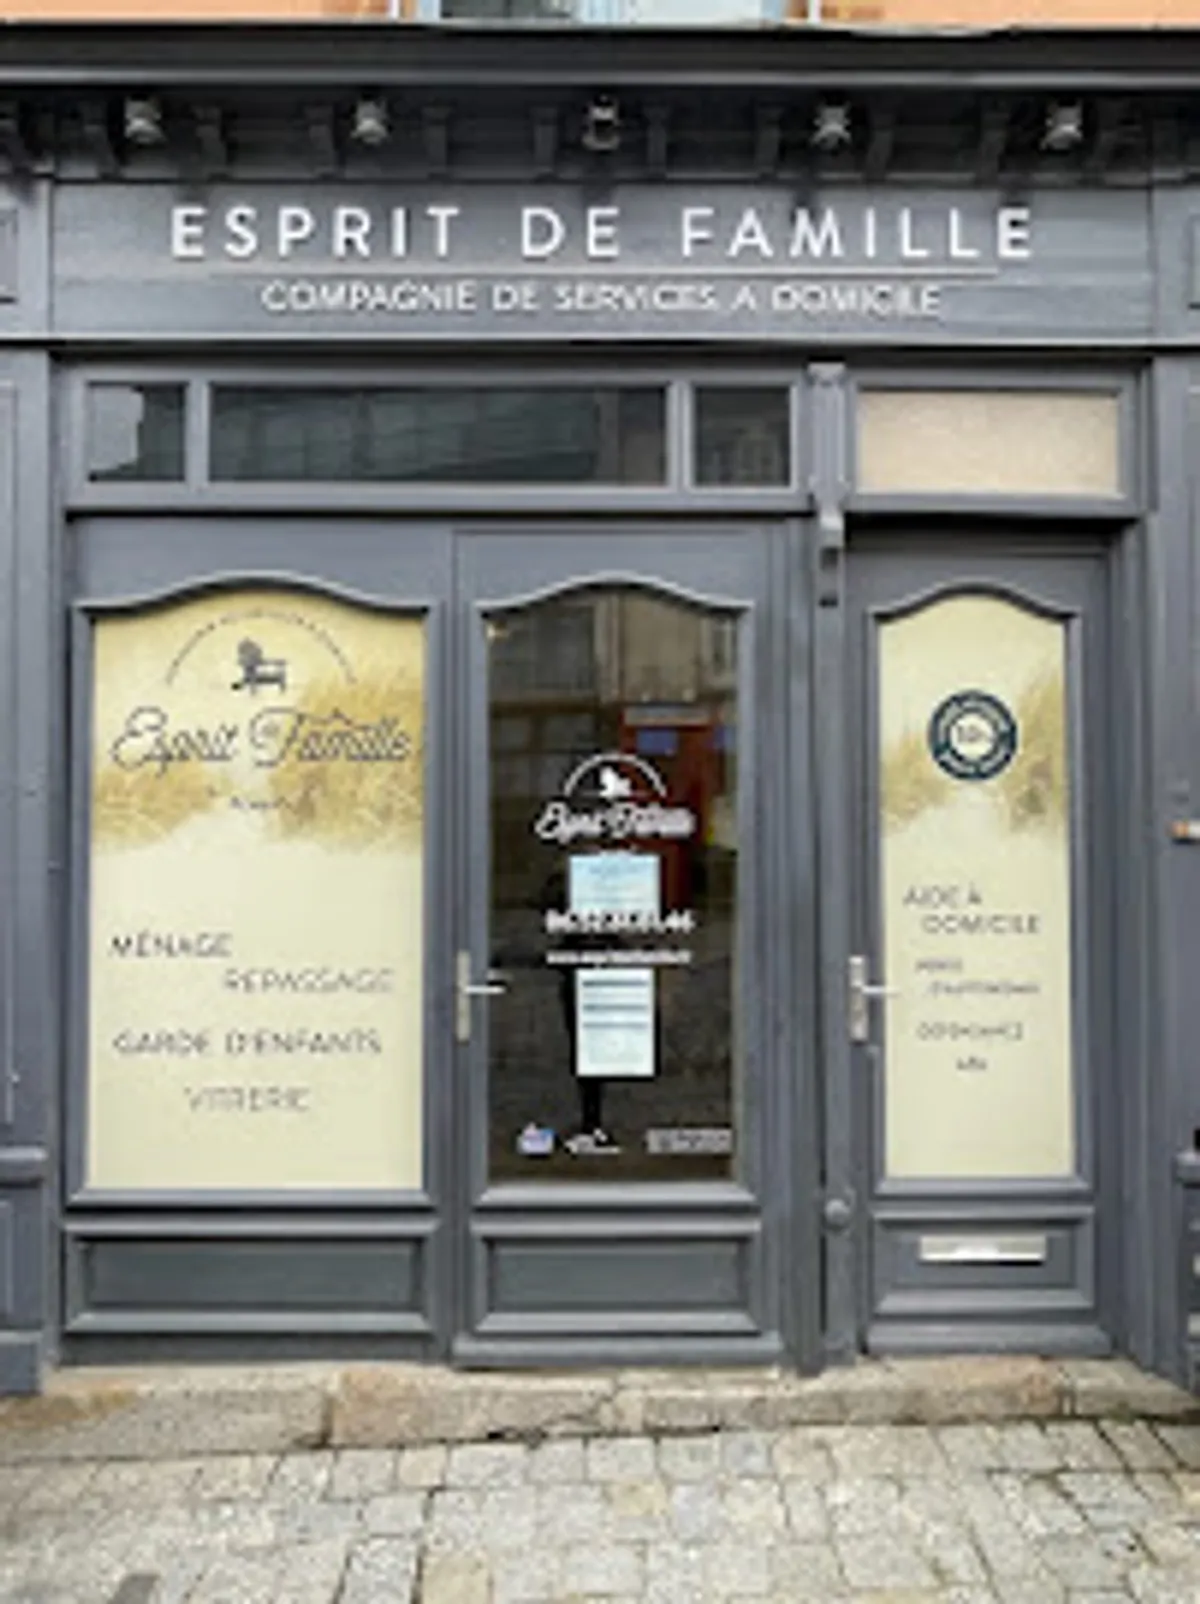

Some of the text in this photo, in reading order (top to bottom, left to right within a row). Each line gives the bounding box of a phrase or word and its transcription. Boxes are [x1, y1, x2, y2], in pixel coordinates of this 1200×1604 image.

[171, 206, 1032, 258] ESPRIT DE FAMILLE
[261, 279, 478, 312] COMPAGNIE
[492, 281, 540, 312] DE
[553, 283, 716, 312] SERVICES
[771, 283, 942, 317] DOMICILE
[109, 930, 233, 958] MÉNAGE
[224, 967, 394, 993] REPASSAGE
[112, 1029, 210, 1054] GARDE
